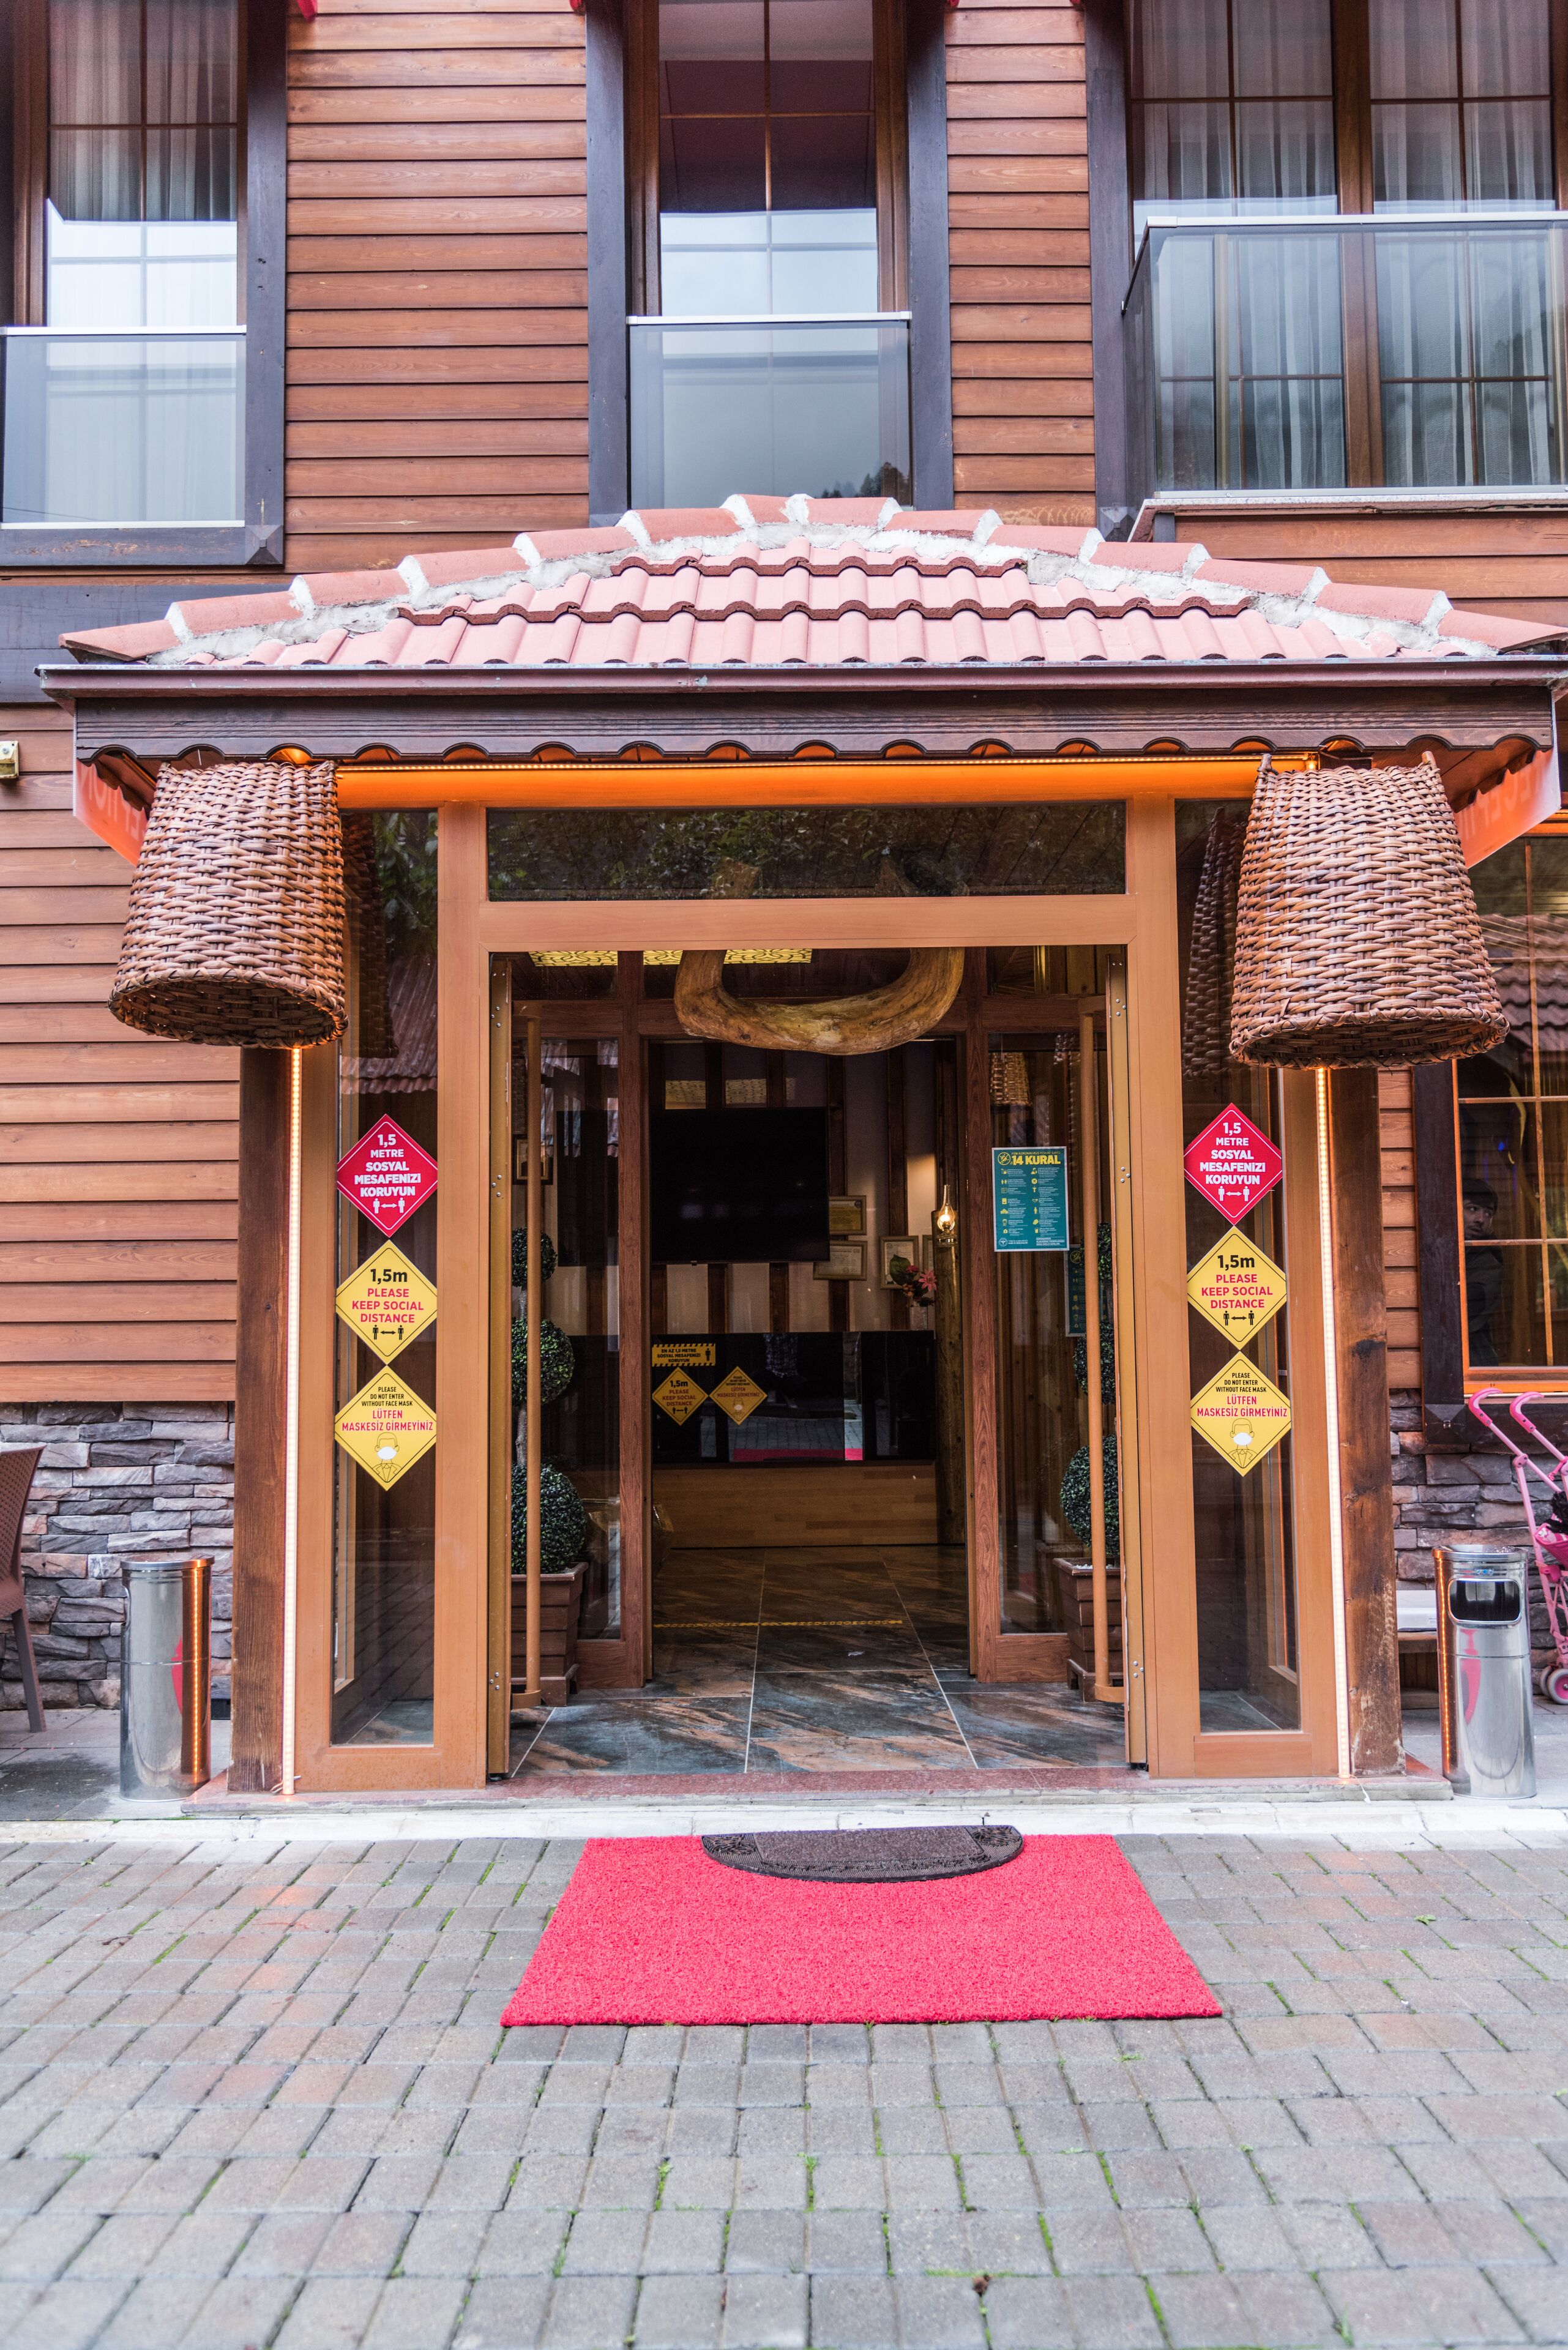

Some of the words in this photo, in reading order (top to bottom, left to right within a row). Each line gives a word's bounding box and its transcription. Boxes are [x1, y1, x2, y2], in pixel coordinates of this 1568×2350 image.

[1223, 1122, 1241, 1136] 1,5
[378, 1134, 397, 1147] 1,5
[1215, 1137, 1249, 1146] METRE
[370, 1149, 404, 1158] METRE
[1211, 1149, 1254, 1160] SOSYAL
[1012, 1155, 1023, 1165] 14
[1025, 1155, 1061, 1165] KURAL
[365, 1161, 409, 1172] SOSYAL
[1200, 1162, 1266, 1173] MESAFENİZİ
[354, 1173, 421, 1185] MESAFENİZİ
[1205, 1174, 1260, 1185] KORUYUN
[360, 1186, 416, 1197] KORUYUN
[1217, 1255, 1255, 1271] 1,5m
[370, 1269, 408, 1285] 1,5m
[1216, 1274, 1258, 1283] PLEASE
[367, 1288, 409, 1297] PLEASE
[1201, 1286, 1230, 1296] KEEP
[1233, 1286, 1273, 1296] SOCIAL
[352, 1300, 380, 1310] KEEP
[383, 1301, 424, 1310] SOCIAL
[1211, 1299, 1264, 1309] DISTANCE
[360, 1313, 415, 1323] DISTANCE
[1227, 1394, 1256, 1404] LÜTFEN
[373, 1408, 403, 1419] LÜTFEN
[1197, 1406, 1238, 1417] MASKESİZ
[1241, 1406, 1287, 1417] GİRMEYİNİZ
[342, 1420, 384, 1431] MASKESİZ
[386, 1420, 433, 1431] GİRMEYİNİZ
